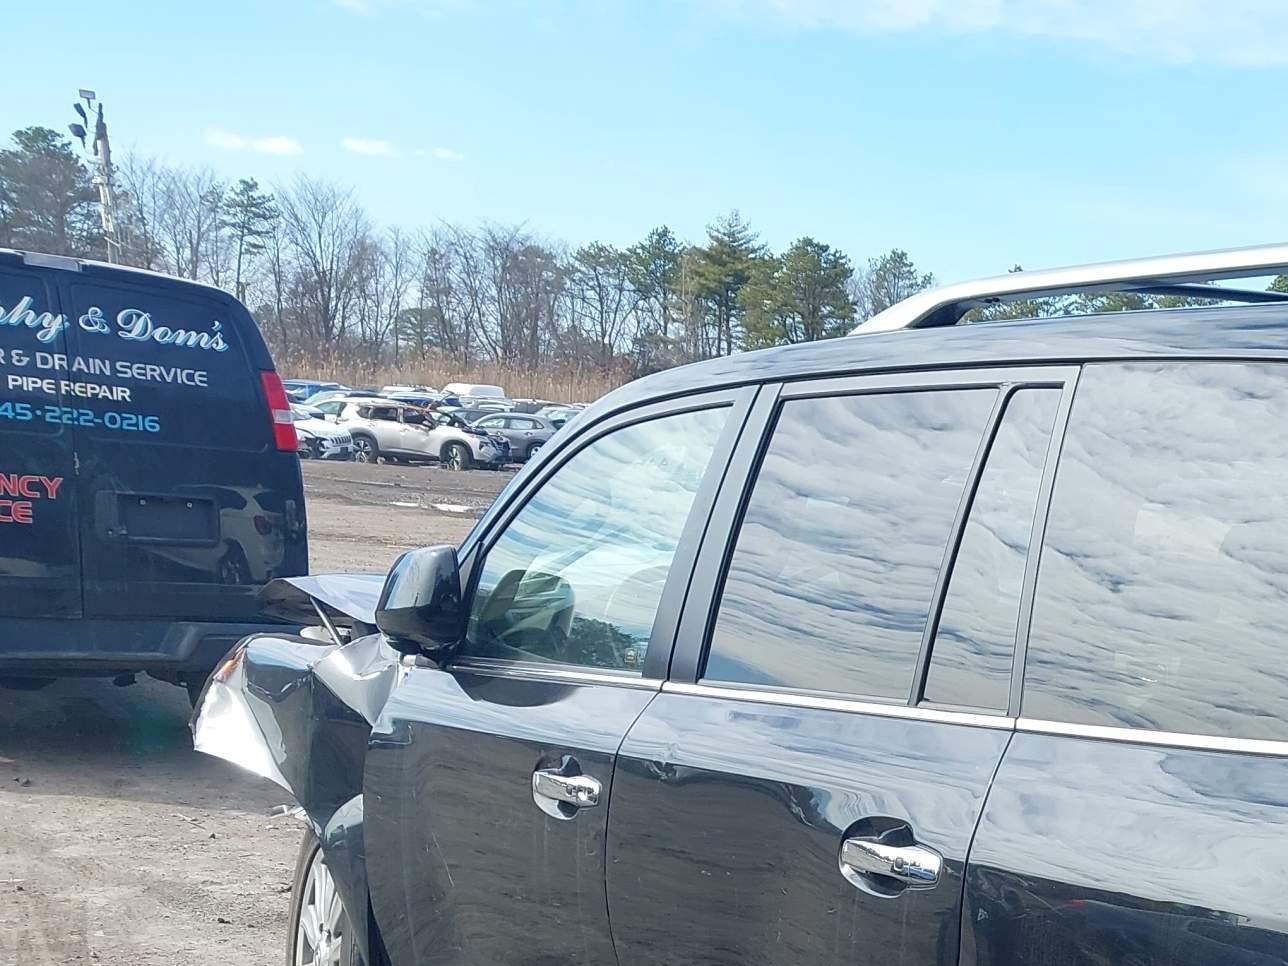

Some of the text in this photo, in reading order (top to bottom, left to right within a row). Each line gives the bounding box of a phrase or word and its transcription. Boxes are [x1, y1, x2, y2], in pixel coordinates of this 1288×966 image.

[79, 306, 111, 334] &
[117, 308, 229, 352] Dom's
[11, 349, 30, 366] &
[35, 351, 111, 376] DRAIN
[115, 361, 208, 387] SERVICE
[8, 374, 131, 402] PIPE REPAIR
[0, 472, 64, 499] NCY
